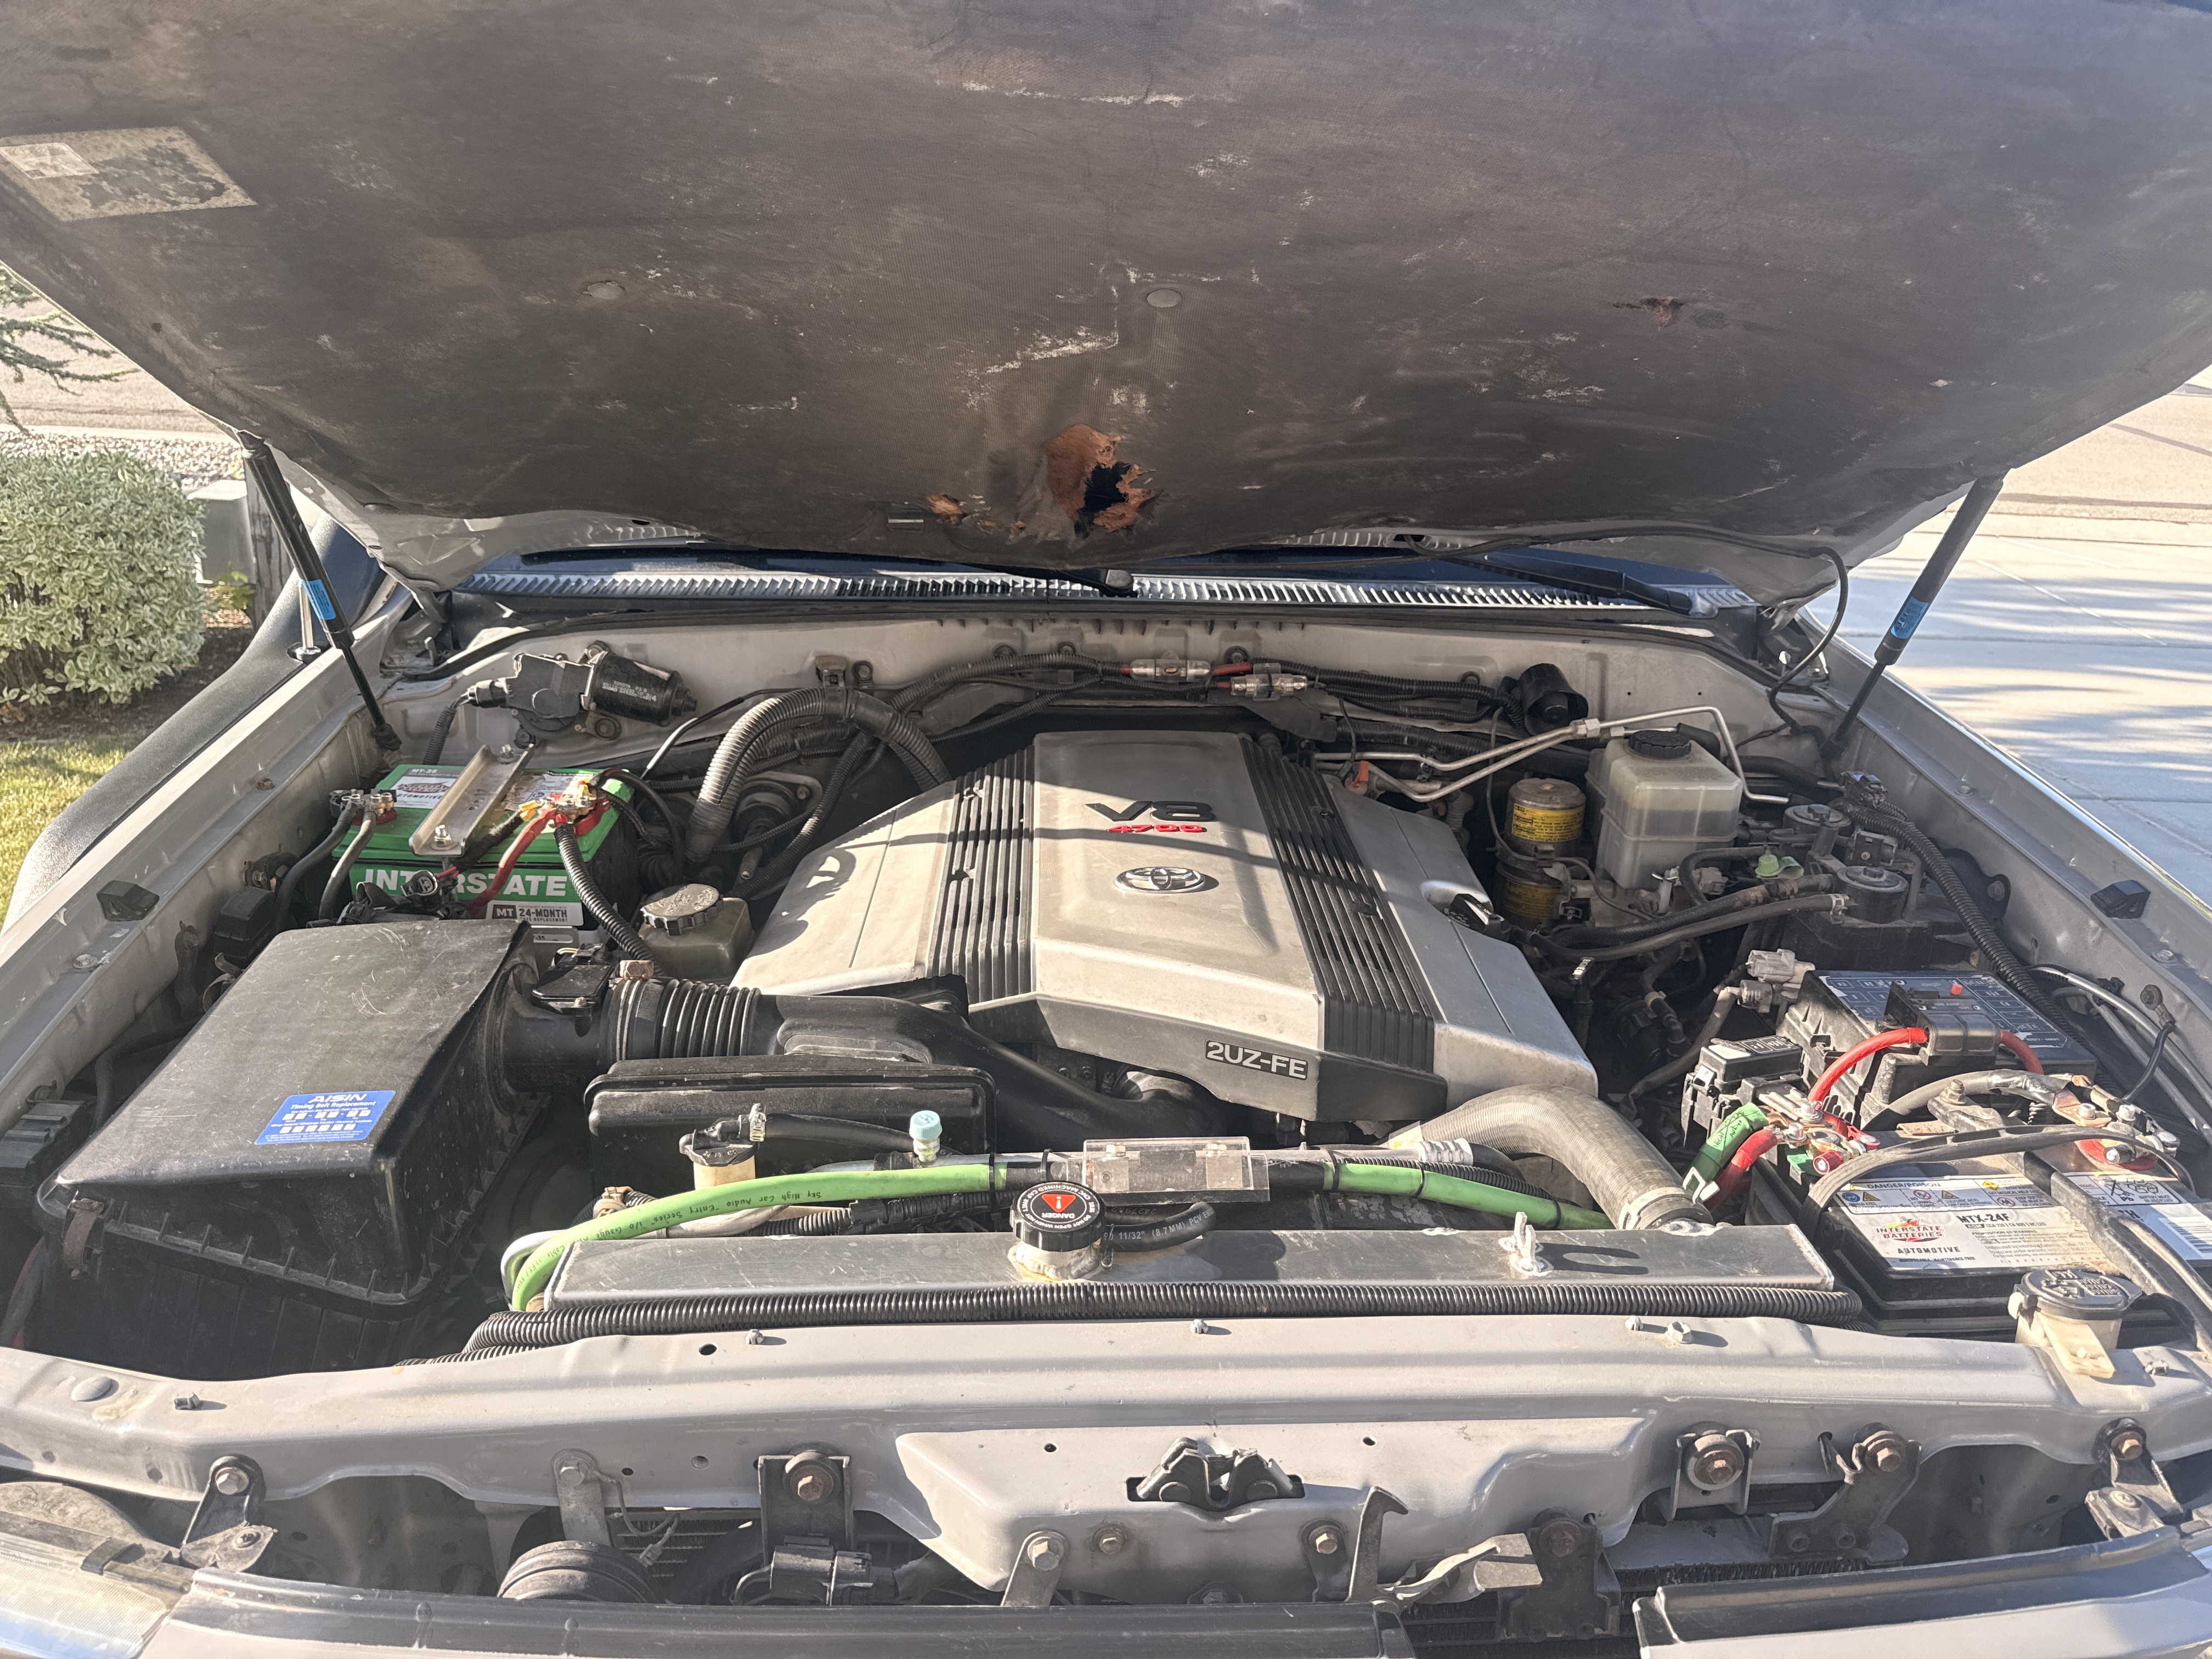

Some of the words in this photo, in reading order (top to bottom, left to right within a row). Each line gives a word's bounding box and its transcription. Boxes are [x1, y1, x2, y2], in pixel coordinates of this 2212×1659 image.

[614, 680, 631, 689] TOYOTA
[1083, 800, 1217, 822] V8
[1107, 824, 1207, 833] 4700
[496, 908, 514, 917] MT
[519, 908, 567, 918] 24-MONTH
[1206, 1041, 1307, 1080] 2UZ-FE
[308, 1093, 368, 1103] AISIN
[1037, 1184, 1079, 1193] MACHINED
[781, 1191, 800, 1200] High
[806, 1190, 822, 1199] Sky
[1026, 1190, 1039, 1199] CAP
[1078, 1190, 1091, 1200] CNC
[726, 1198, 752, 1207] Audio
[1956, 1213, 2010, 1223] MTX-24F
[1034, 1220, 1053, 1229] WHEN
[1119, 1231, 1146, 1240] 11/32"
[1152, 1221, 1186, 1238] (8.7MM)
[1188, 1215, 1202, 1226] PCV
[1876, 1225, 1942, 1233] INTERSTATE
[595, 1226, 622, 1239] Gauge
[1883, 1231, 1943, 1239] BATTERIES
[1897, 1246, 1961, 1254] AUTOMOTIVE
